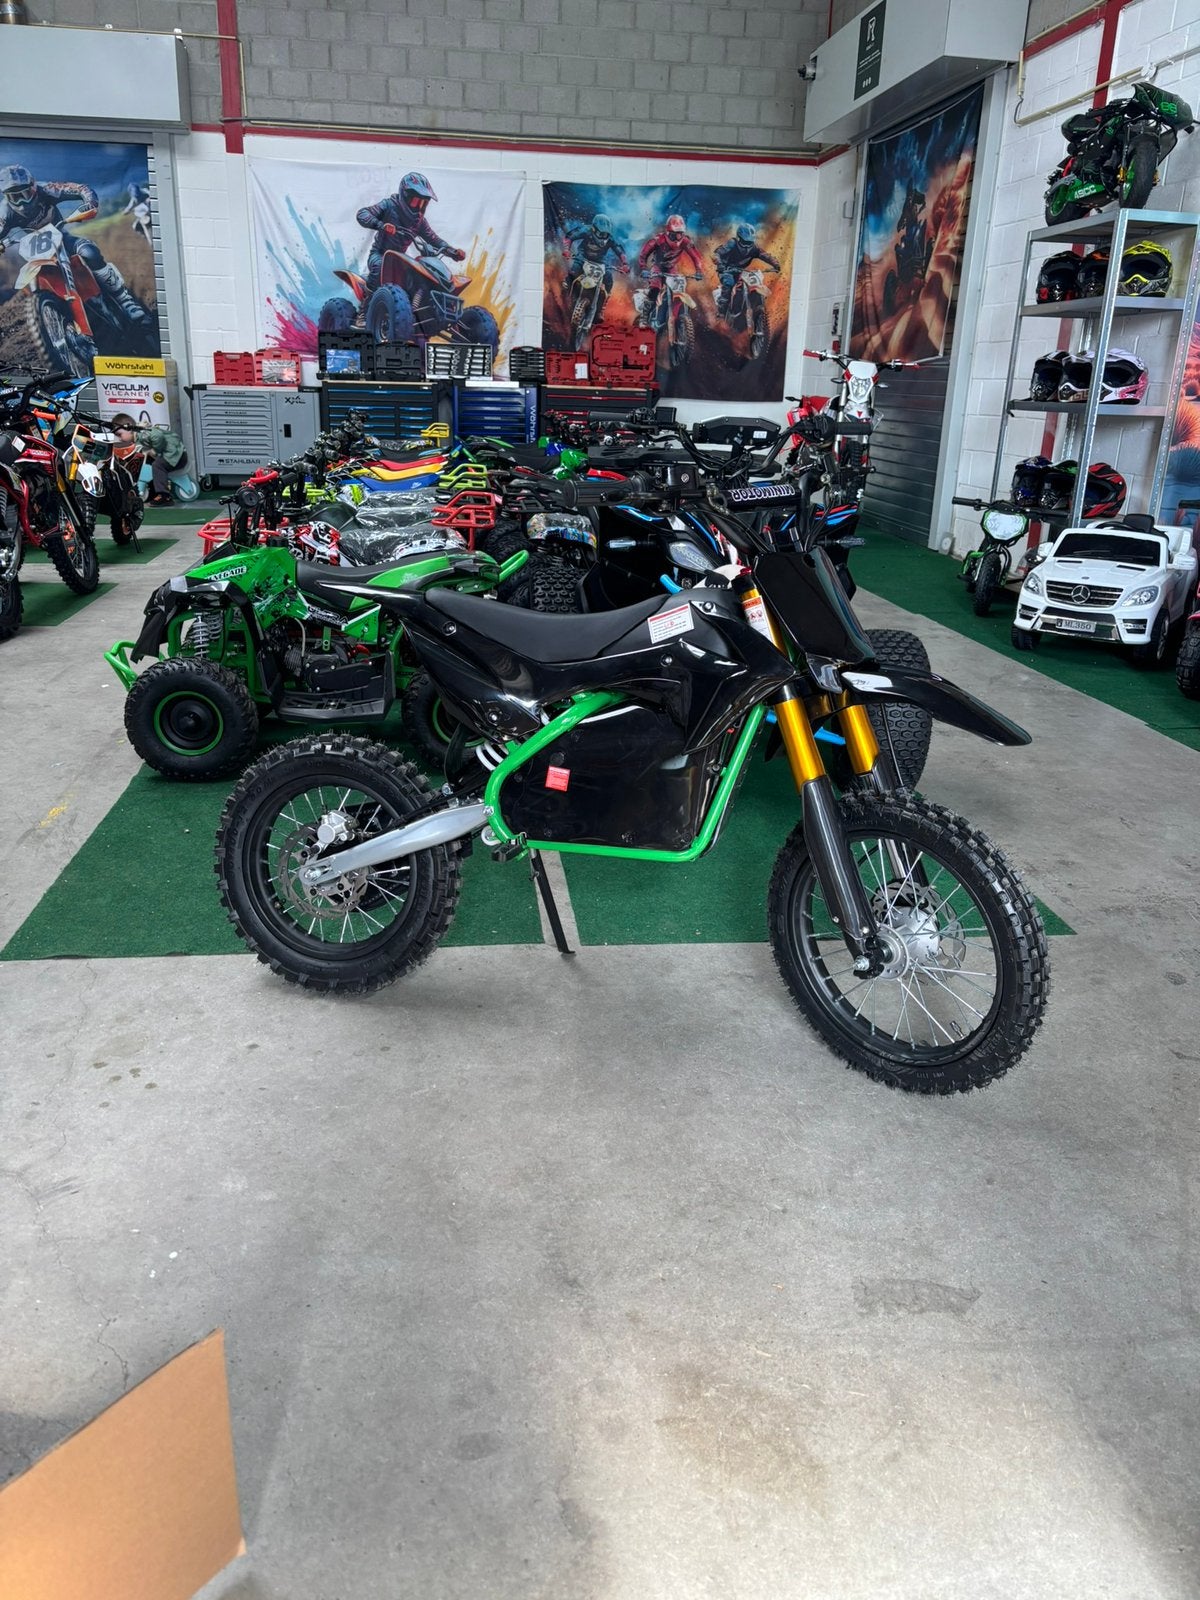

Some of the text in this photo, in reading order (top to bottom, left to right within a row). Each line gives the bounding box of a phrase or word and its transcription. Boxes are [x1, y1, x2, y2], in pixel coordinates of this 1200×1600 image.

[1074, 185, 1097, 199] 49CC
[105, 362, 154, 370] Wöhrstahl
[102, 382, 149, 391] VACUUM
[731, 484, 796, 502] MINIMOTOR
